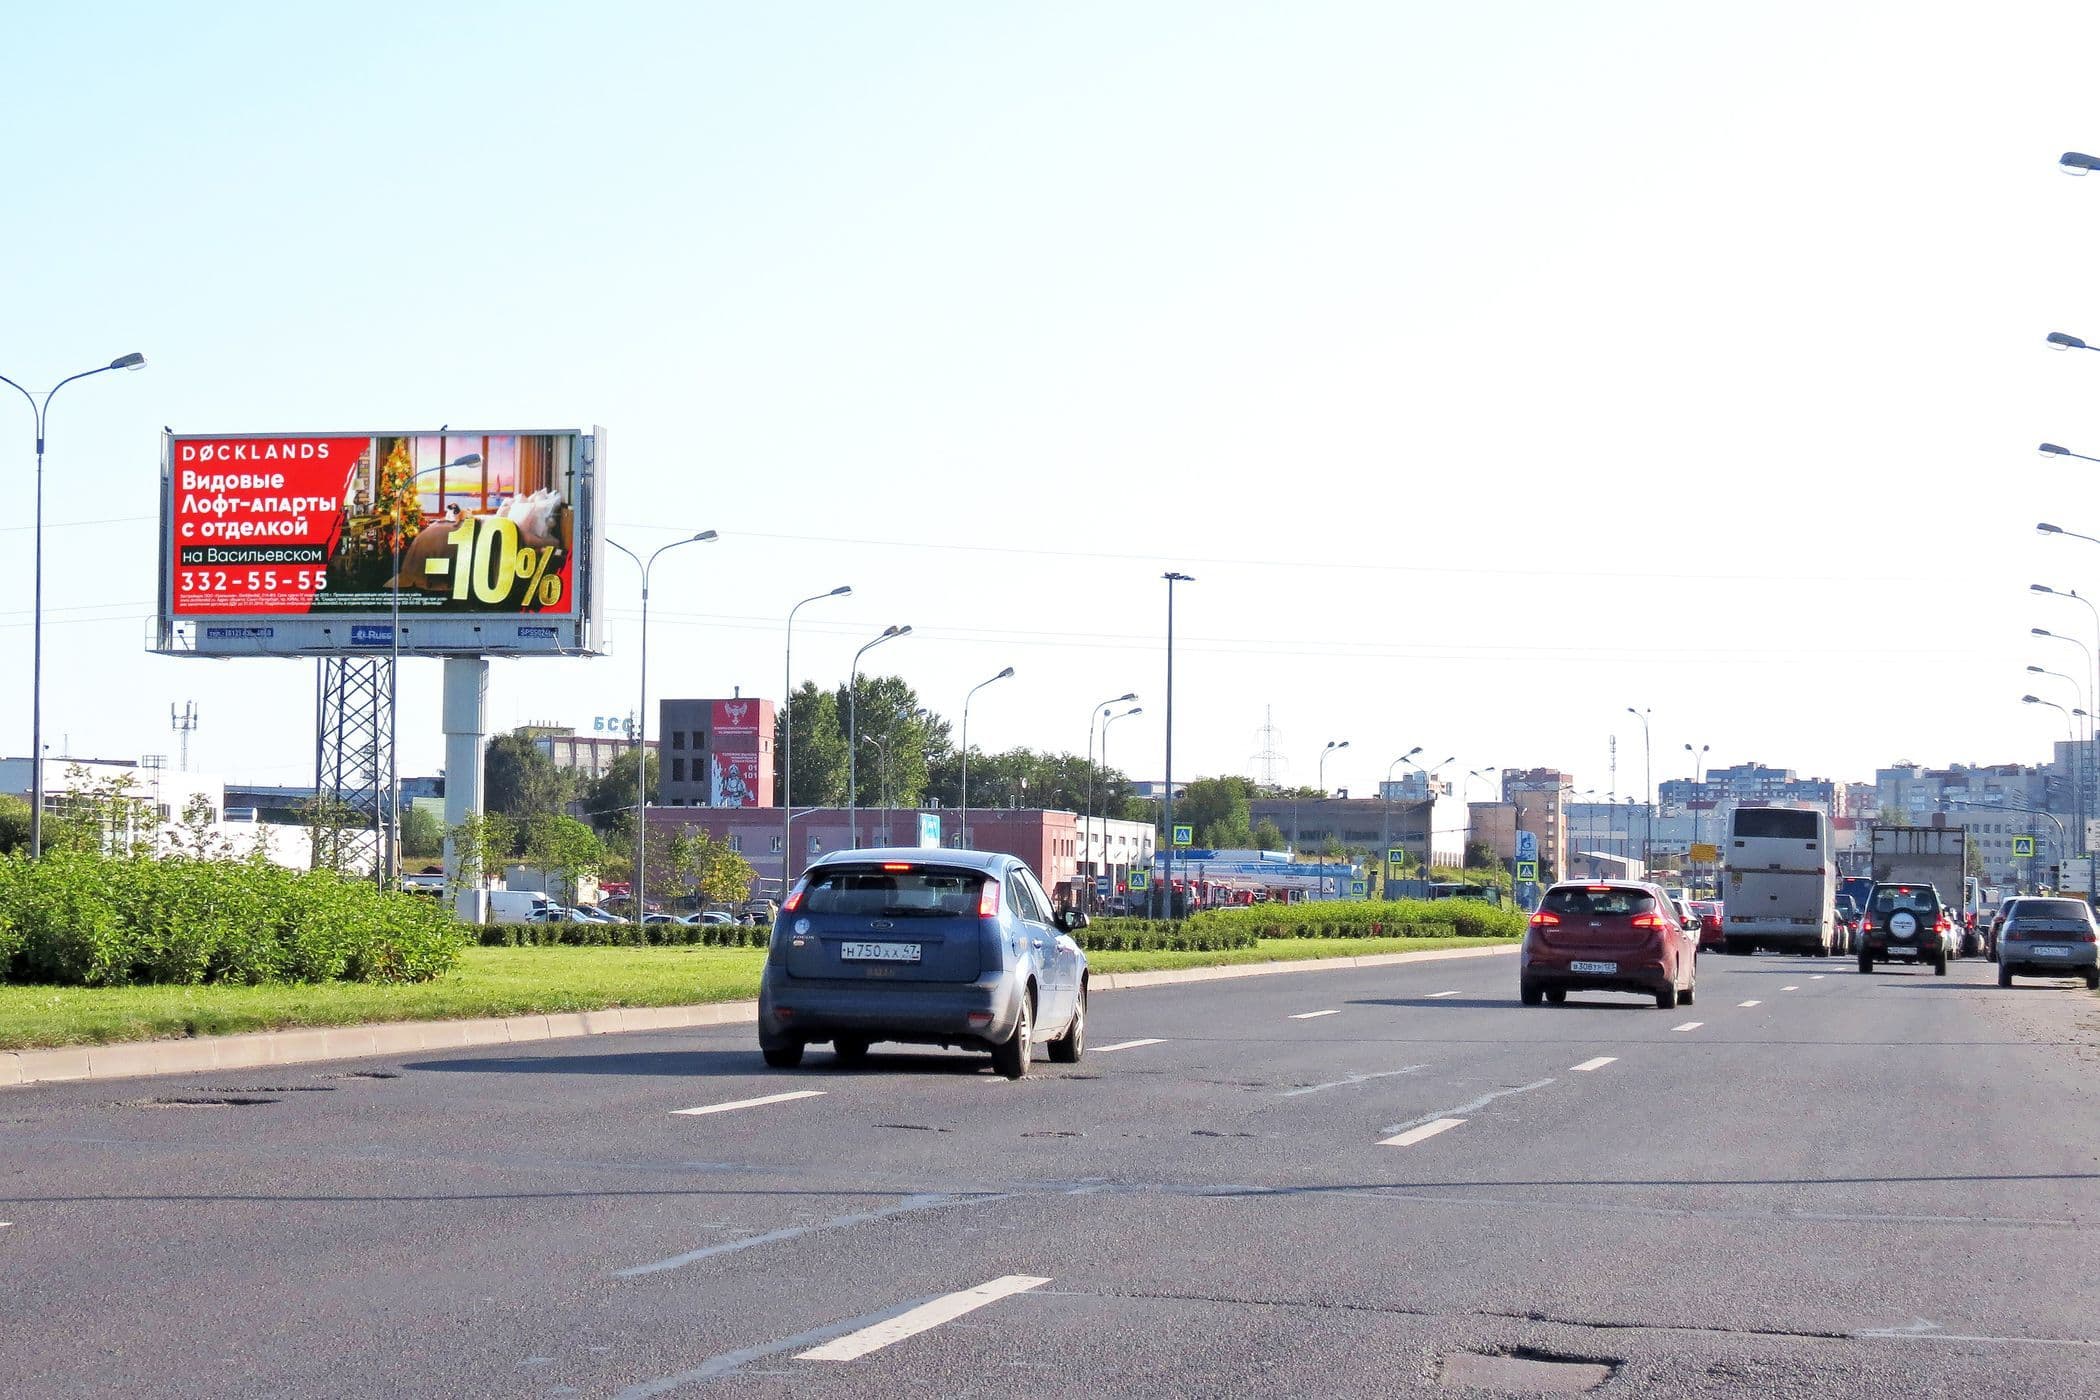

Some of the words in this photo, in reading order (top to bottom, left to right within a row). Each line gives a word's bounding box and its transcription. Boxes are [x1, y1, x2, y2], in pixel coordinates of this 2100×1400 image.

[182, 470, 285, 492] Видовые
[181, 493, 337, 518] Лофт-апарты
[181, 522, 194, 537] с
[201, 516, 308, 540] отделкой
[182, 551, 203, 563] на
[207, 547, 322, 562] Васильевском
[181, 570, 327, 591] 332-55-55
